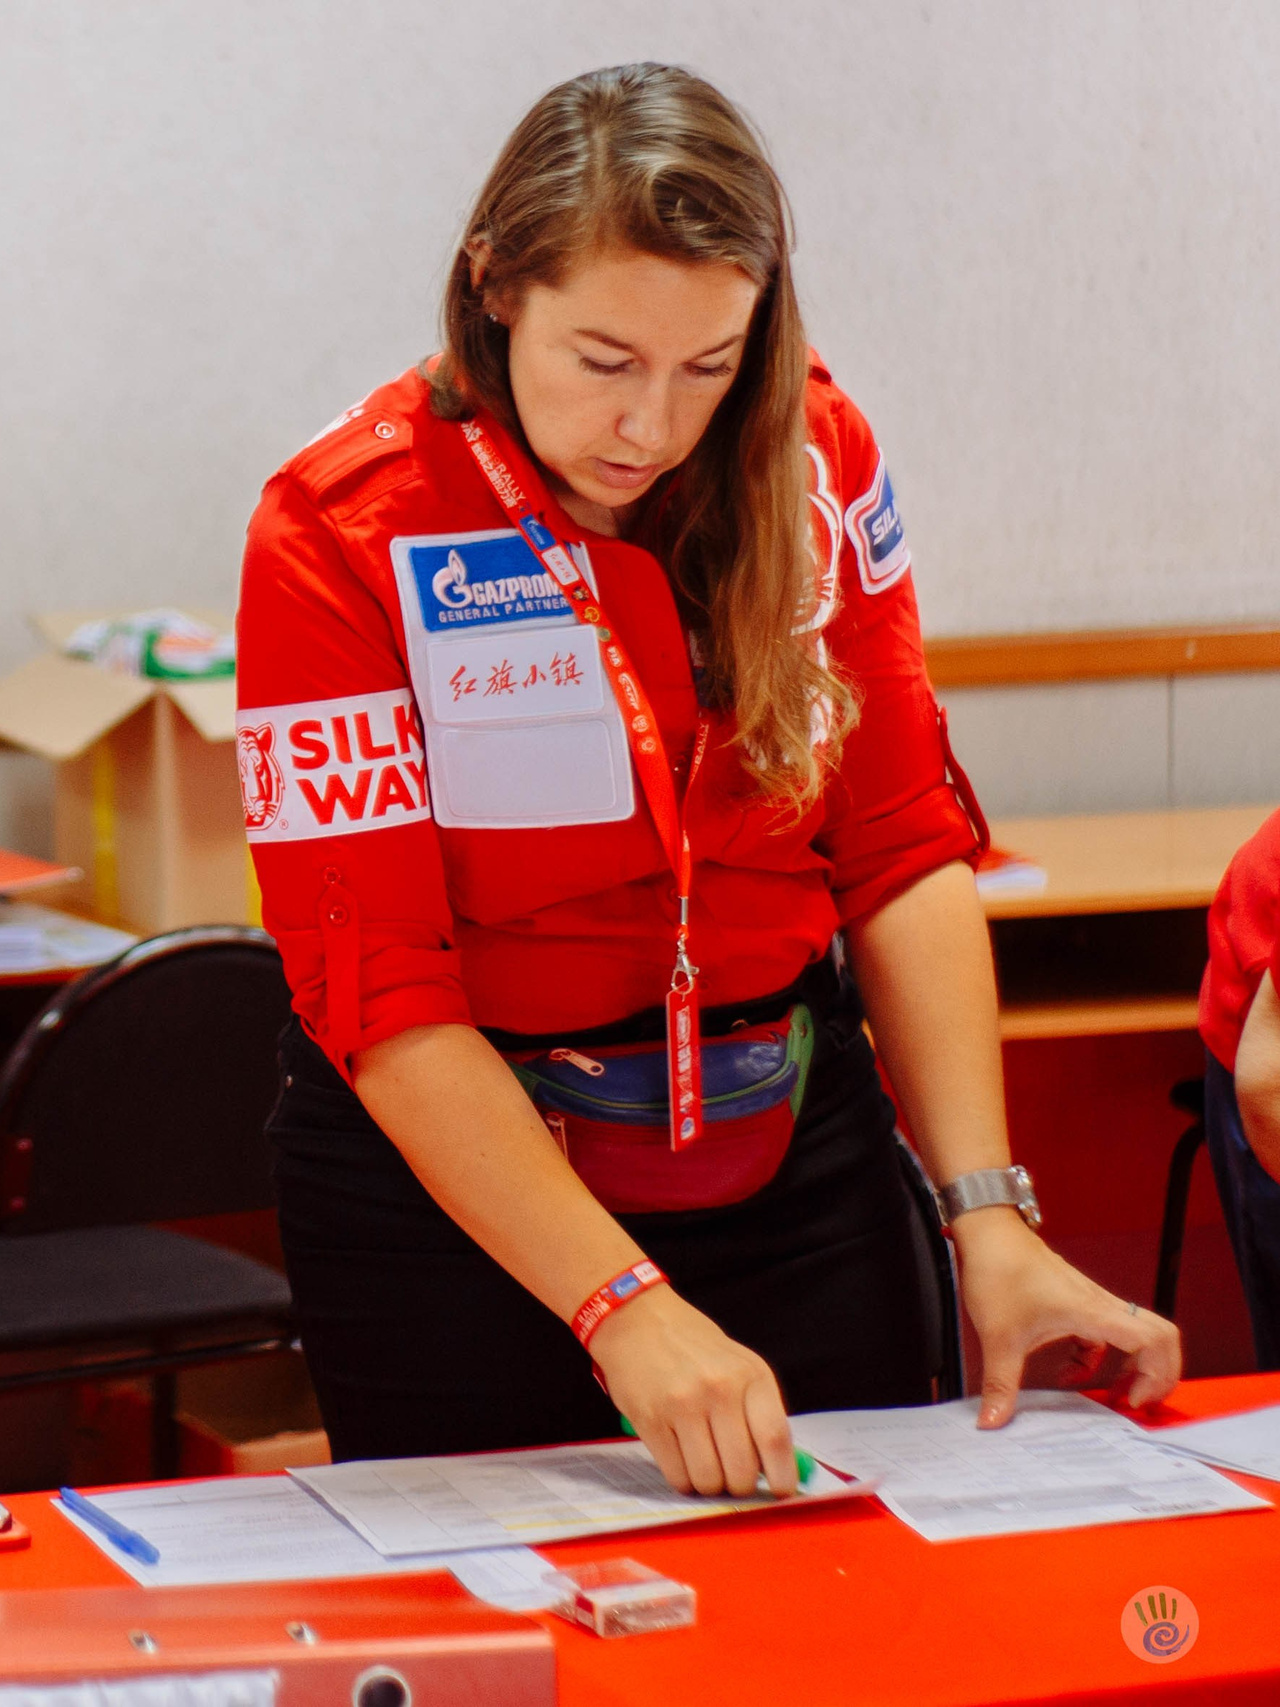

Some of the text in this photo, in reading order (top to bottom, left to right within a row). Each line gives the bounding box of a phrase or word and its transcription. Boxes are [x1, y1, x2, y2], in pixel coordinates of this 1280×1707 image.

[496, 463, 526, 501] RALLY
[871, 505, 898, 546] SIL
[438, 598, 570, 623] GENERAL PARTNER
[448, 652, 584, 703] 红旗小镇
[288, 700, 425, 771] SILK
[295, 757, 428, 826] WAY
